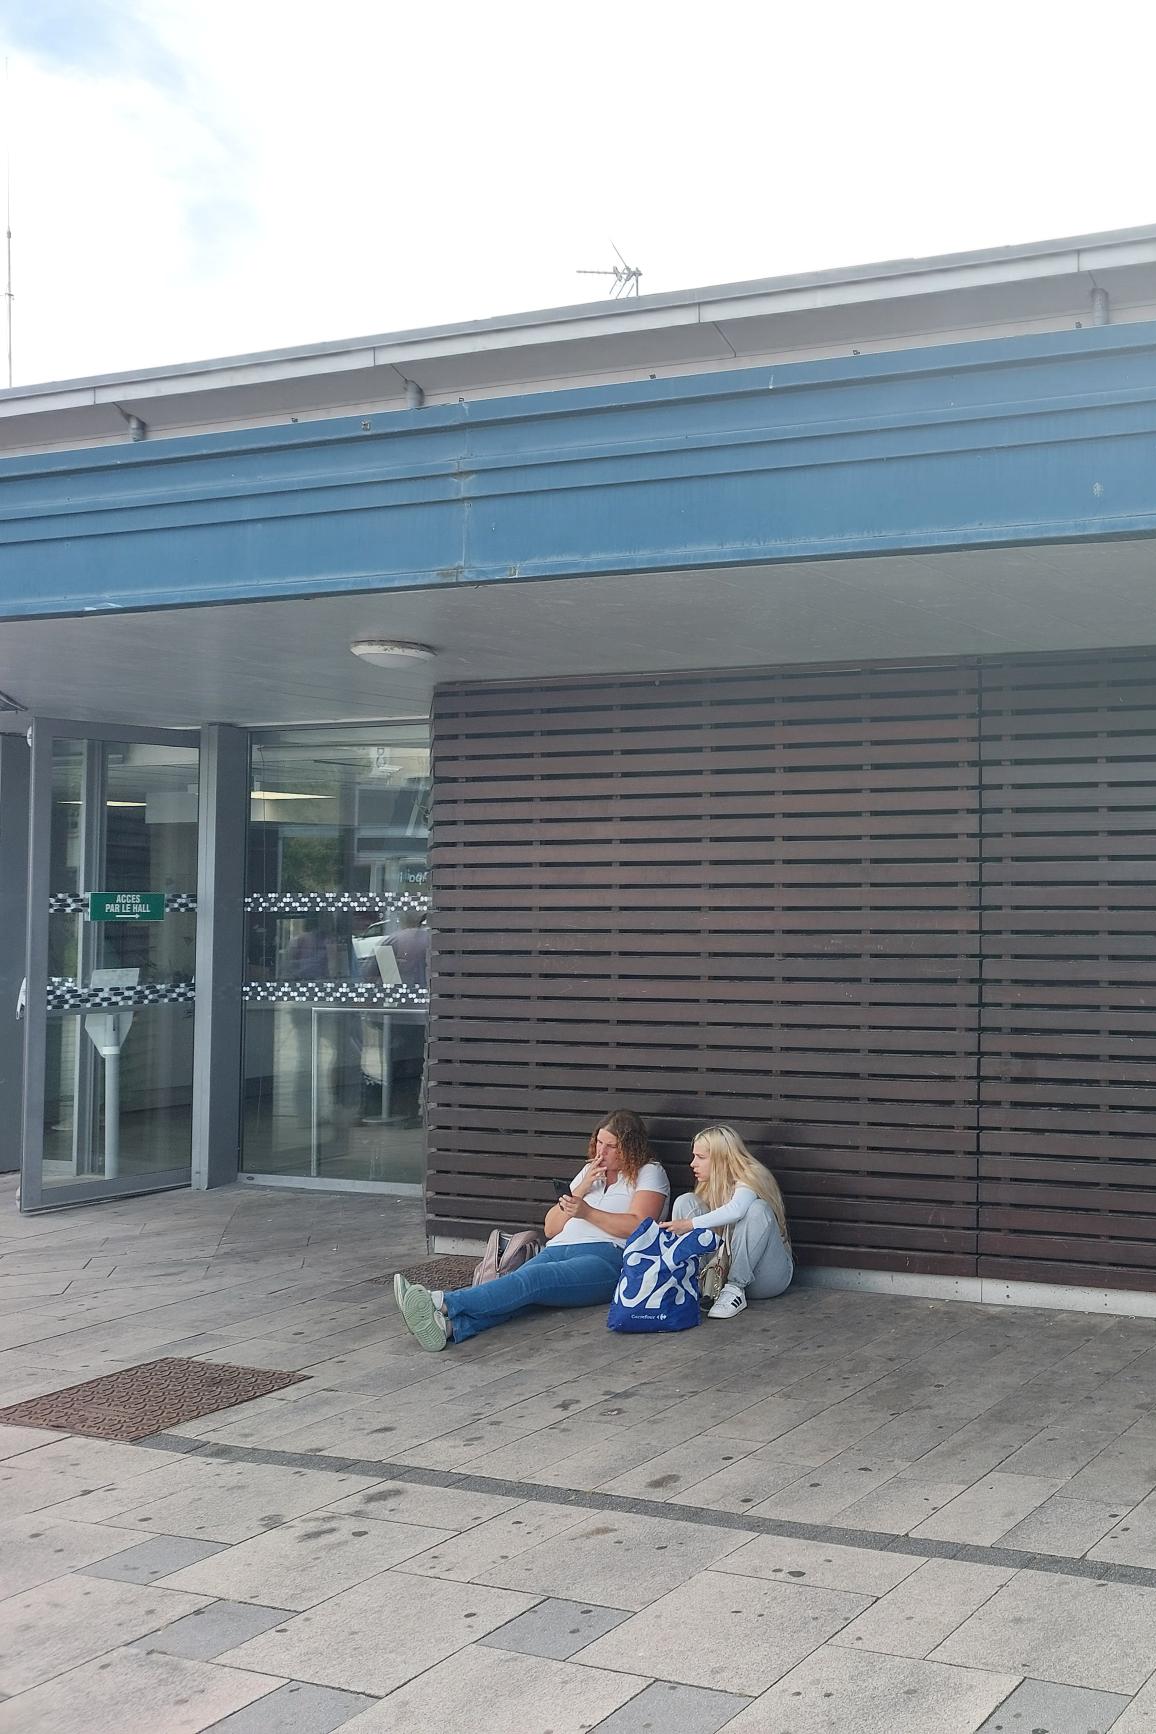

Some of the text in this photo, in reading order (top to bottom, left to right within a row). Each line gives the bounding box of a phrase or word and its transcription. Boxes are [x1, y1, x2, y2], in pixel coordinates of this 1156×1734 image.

[116, 894, 141, 904] ACCES
[105, 904, 151, 913] PAR LE HALL
